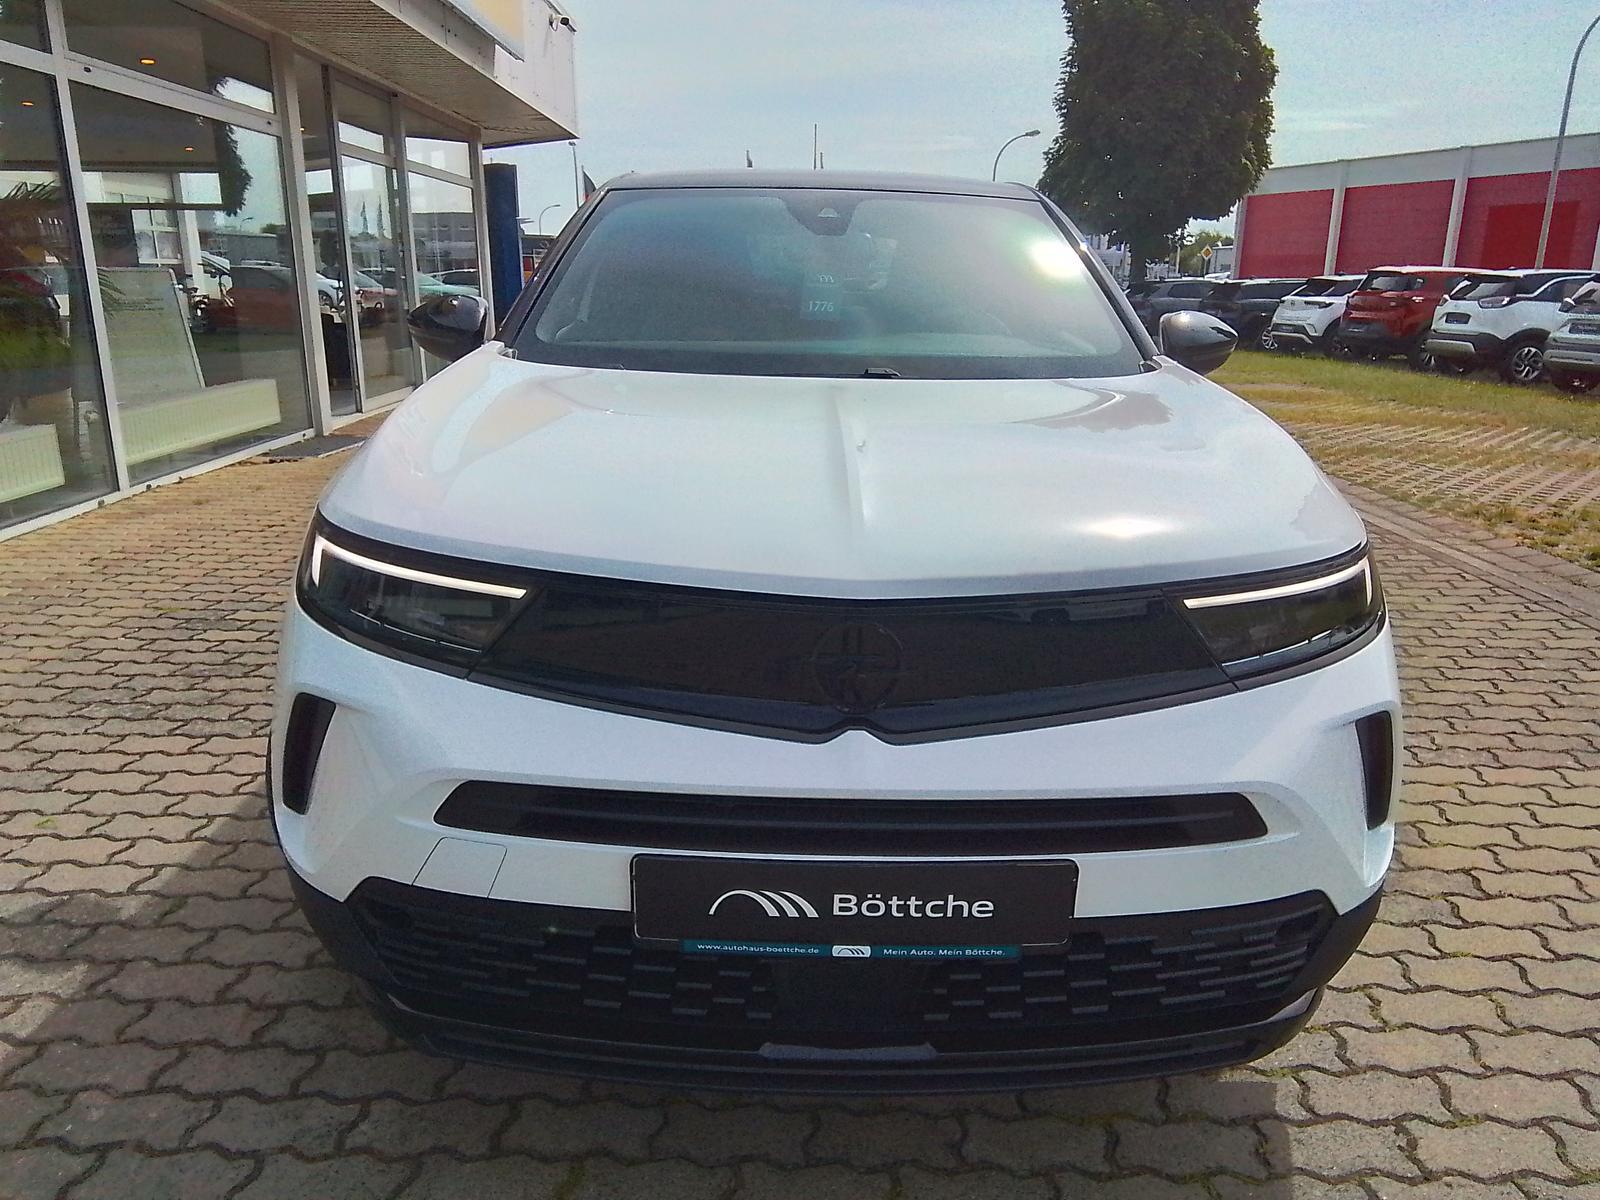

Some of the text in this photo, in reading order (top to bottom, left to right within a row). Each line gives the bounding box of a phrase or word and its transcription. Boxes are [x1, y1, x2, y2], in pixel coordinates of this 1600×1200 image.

[808, 300, 834, 312] 1776
[832, 893, 995, 918] Böttche
[697, 943, 819, 954] www.autohaus-boettche.de
[883, 948, 1005, 957] Mein Auto. Mein Böttche.
